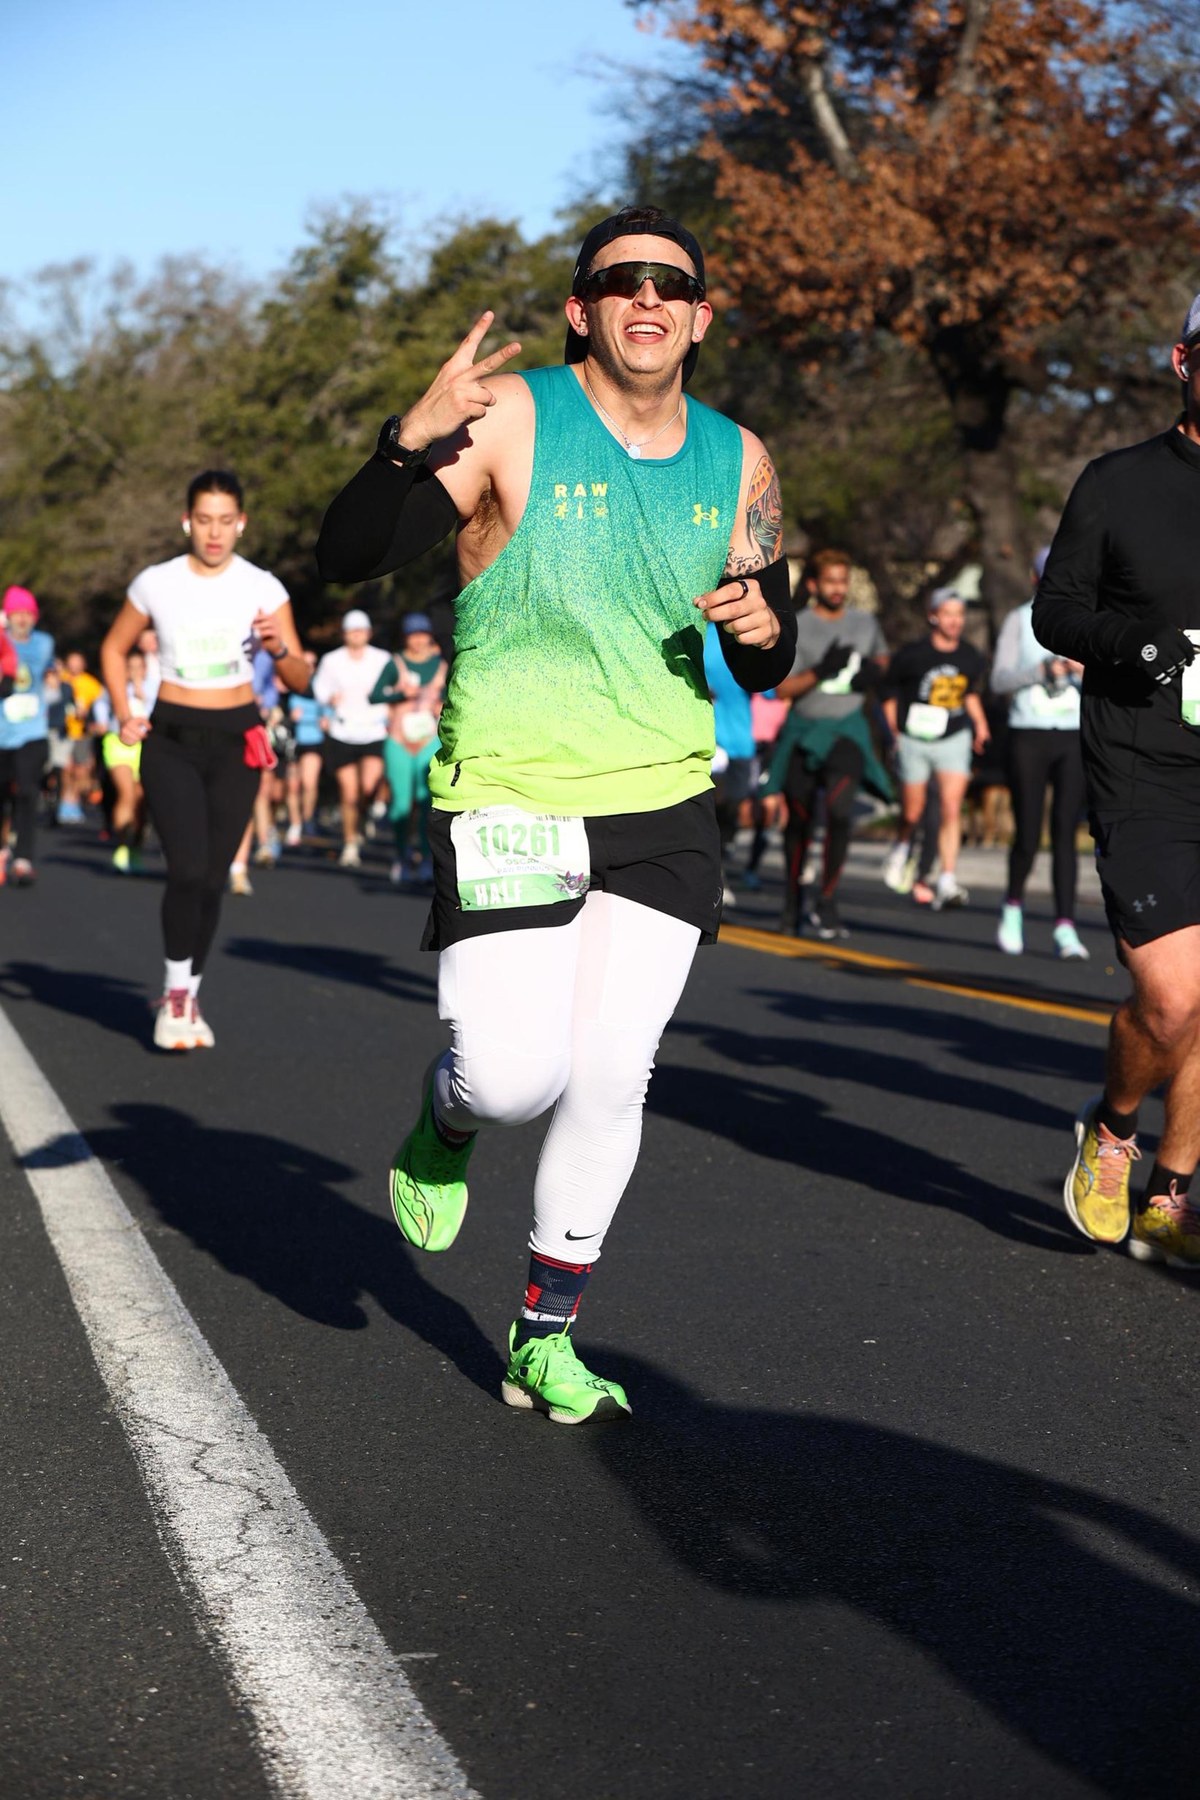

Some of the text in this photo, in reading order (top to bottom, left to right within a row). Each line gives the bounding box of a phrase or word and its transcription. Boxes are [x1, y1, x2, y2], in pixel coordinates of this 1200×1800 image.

[554, 483, 608, 498] RAW
[476, 824, 560, 858] 10261
[474, 880, 521, 906] HALF
